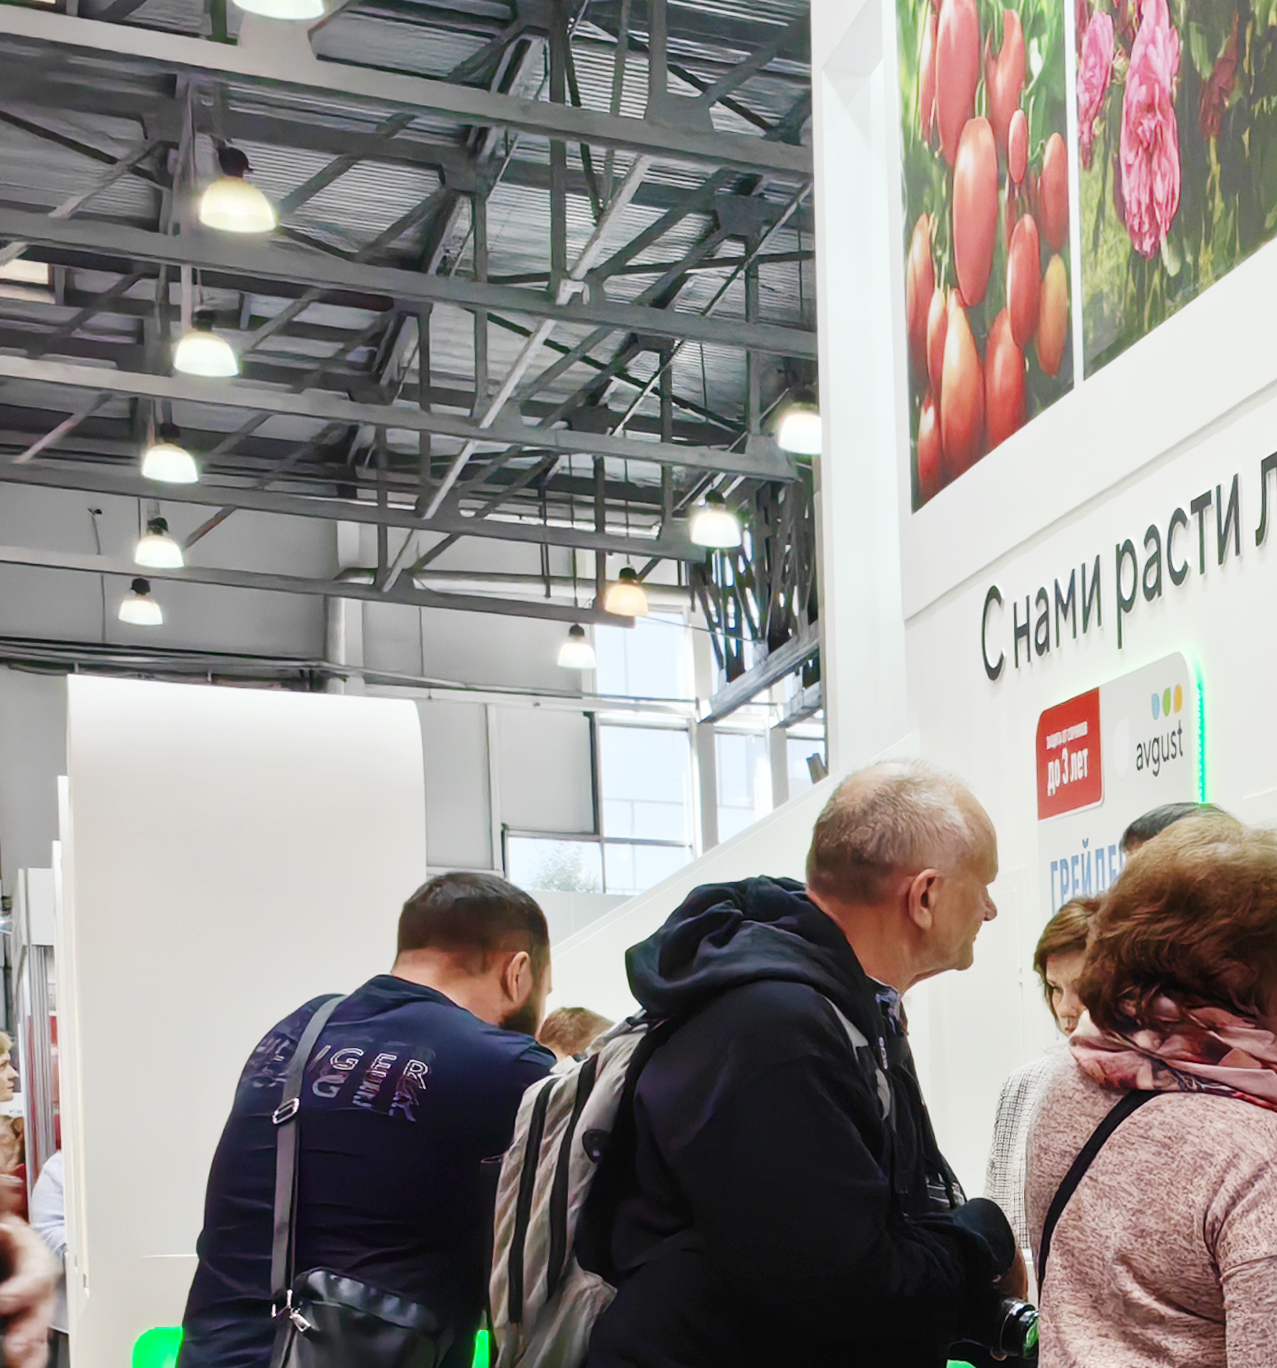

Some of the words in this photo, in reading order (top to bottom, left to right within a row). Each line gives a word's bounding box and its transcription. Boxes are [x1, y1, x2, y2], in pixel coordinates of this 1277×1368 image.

[981, 585, 1005, 681] С
[1013, 554, 1102, 668] нами
[1116, 473, 1240, 649] расти
[1047, 761, 1060, 796] до
[1062, 747, 1068, 784] 3
[1070, 748, 1088, 781] лет
[1136, 720, 1183, 777] avgust
